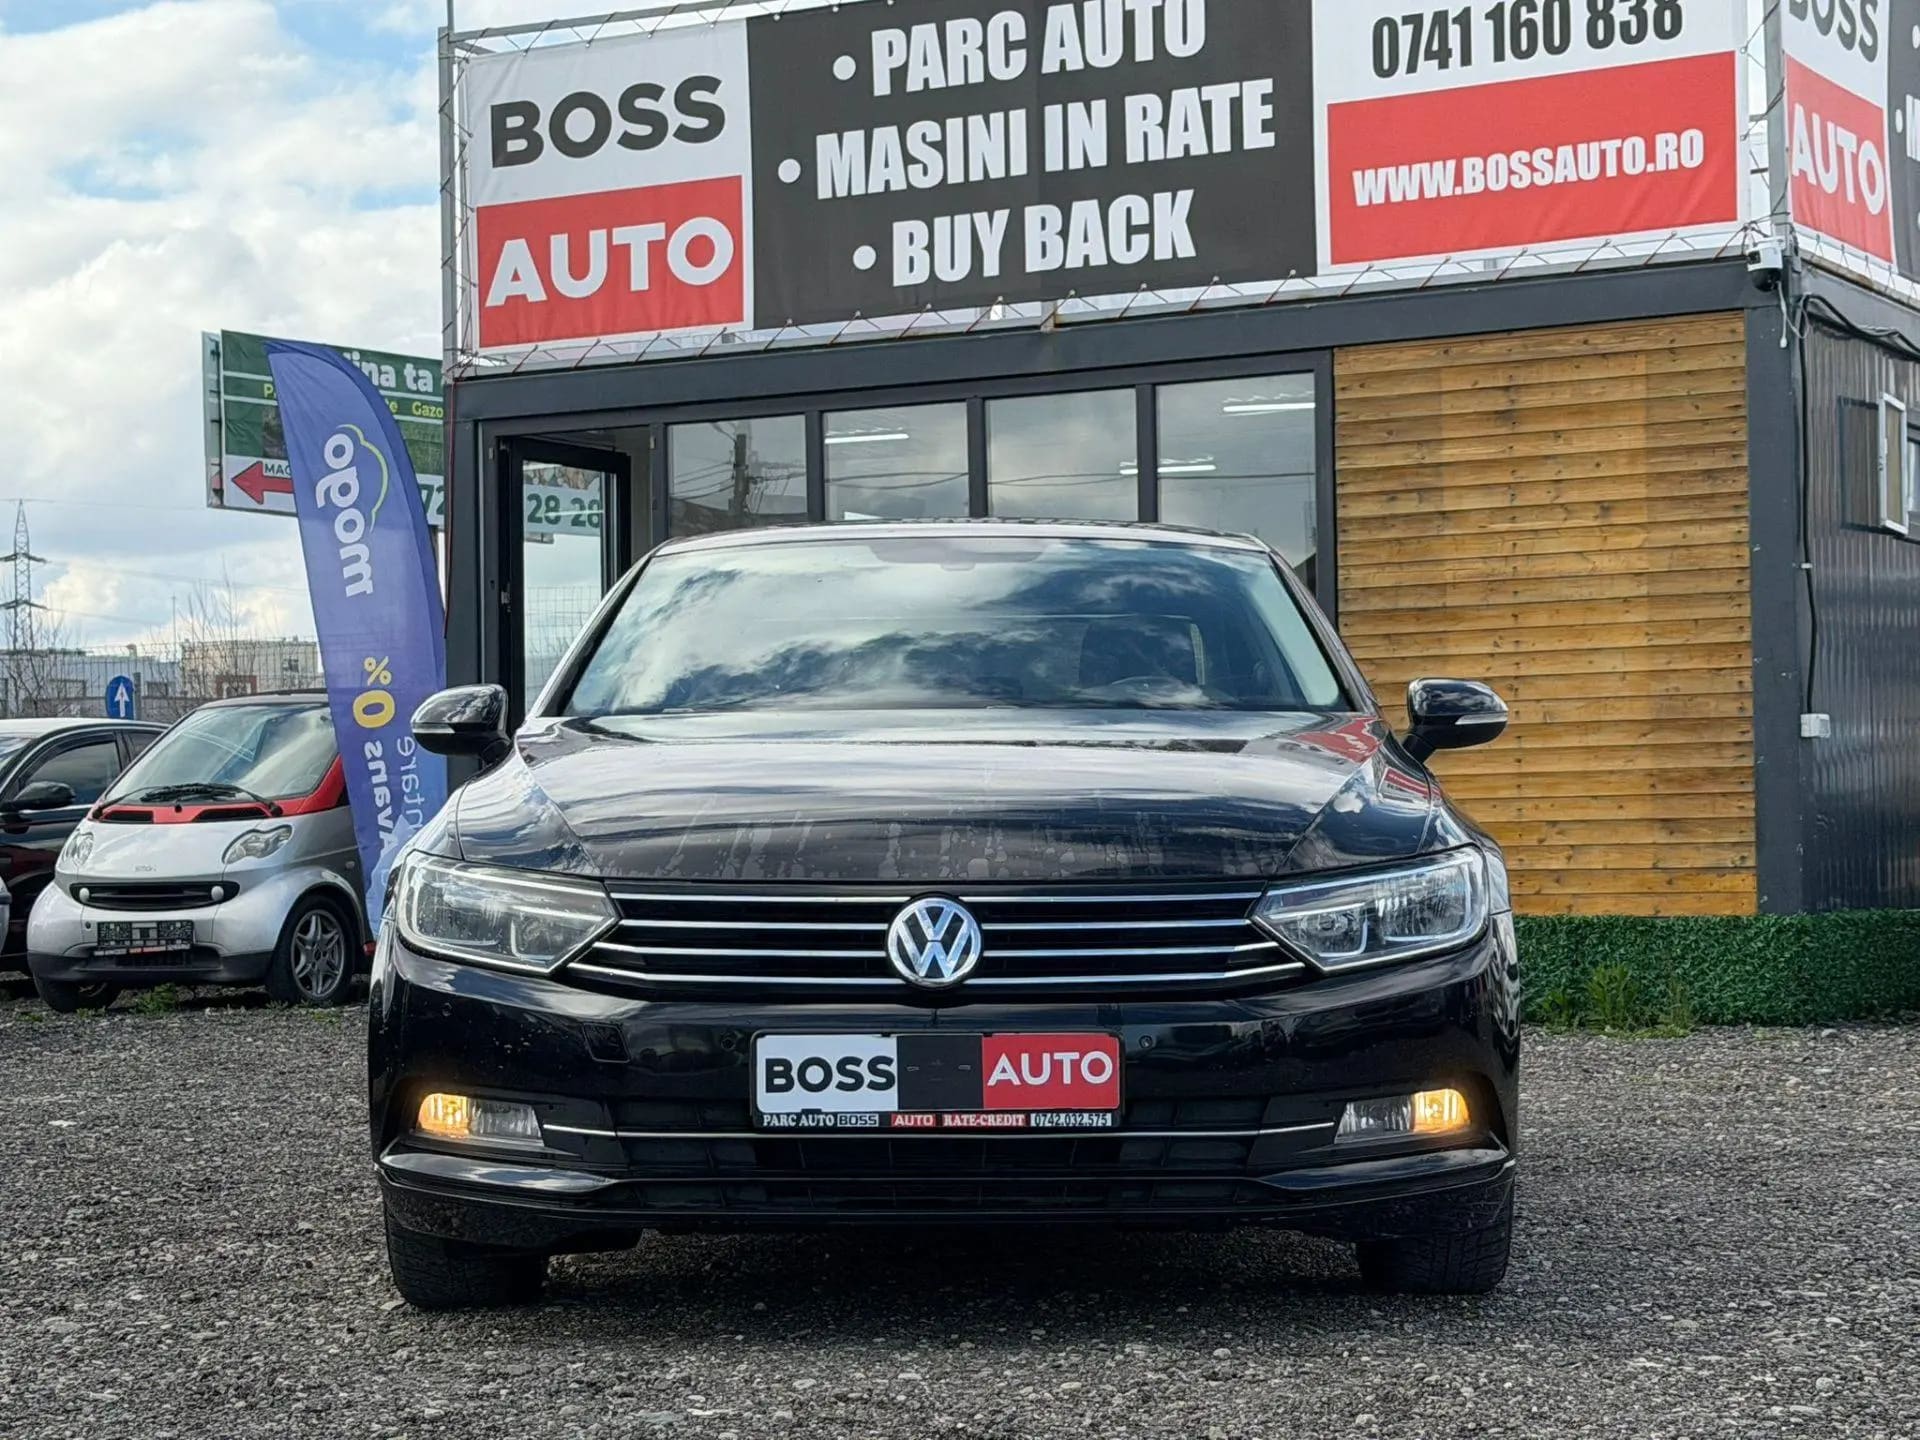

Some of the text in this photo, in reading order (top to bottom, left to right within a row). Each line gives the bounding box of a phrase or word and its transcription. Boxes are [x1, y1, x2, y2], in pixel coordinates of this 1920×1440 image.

[871, 0, 1206, 96] PARC AUTO
[1373, 0, 1683, 78] 0741 160 838
[491, 75, 725, 168] BOSS
[816, 78, 1276, 199] MASINI IN RATE
[1792, 103, 1884, 215] AUTO
[1352, 128, 1703, 206] WWW.BOSSAUTO.RO
[486, 216, 735, 306] AUTO
[893, 189, 1196, 287] BUY BACK
[527, 493, 561, 525] 28
[765, 1050, 1113, 1093] BOSS AUTO
[763, 1113, 796, 1127] PARC
[799, 1113, 834, 1127] AUTO
[839, 1114, 878, 1127] BOSS
[894, 1114, 934, 1127] AUTO
